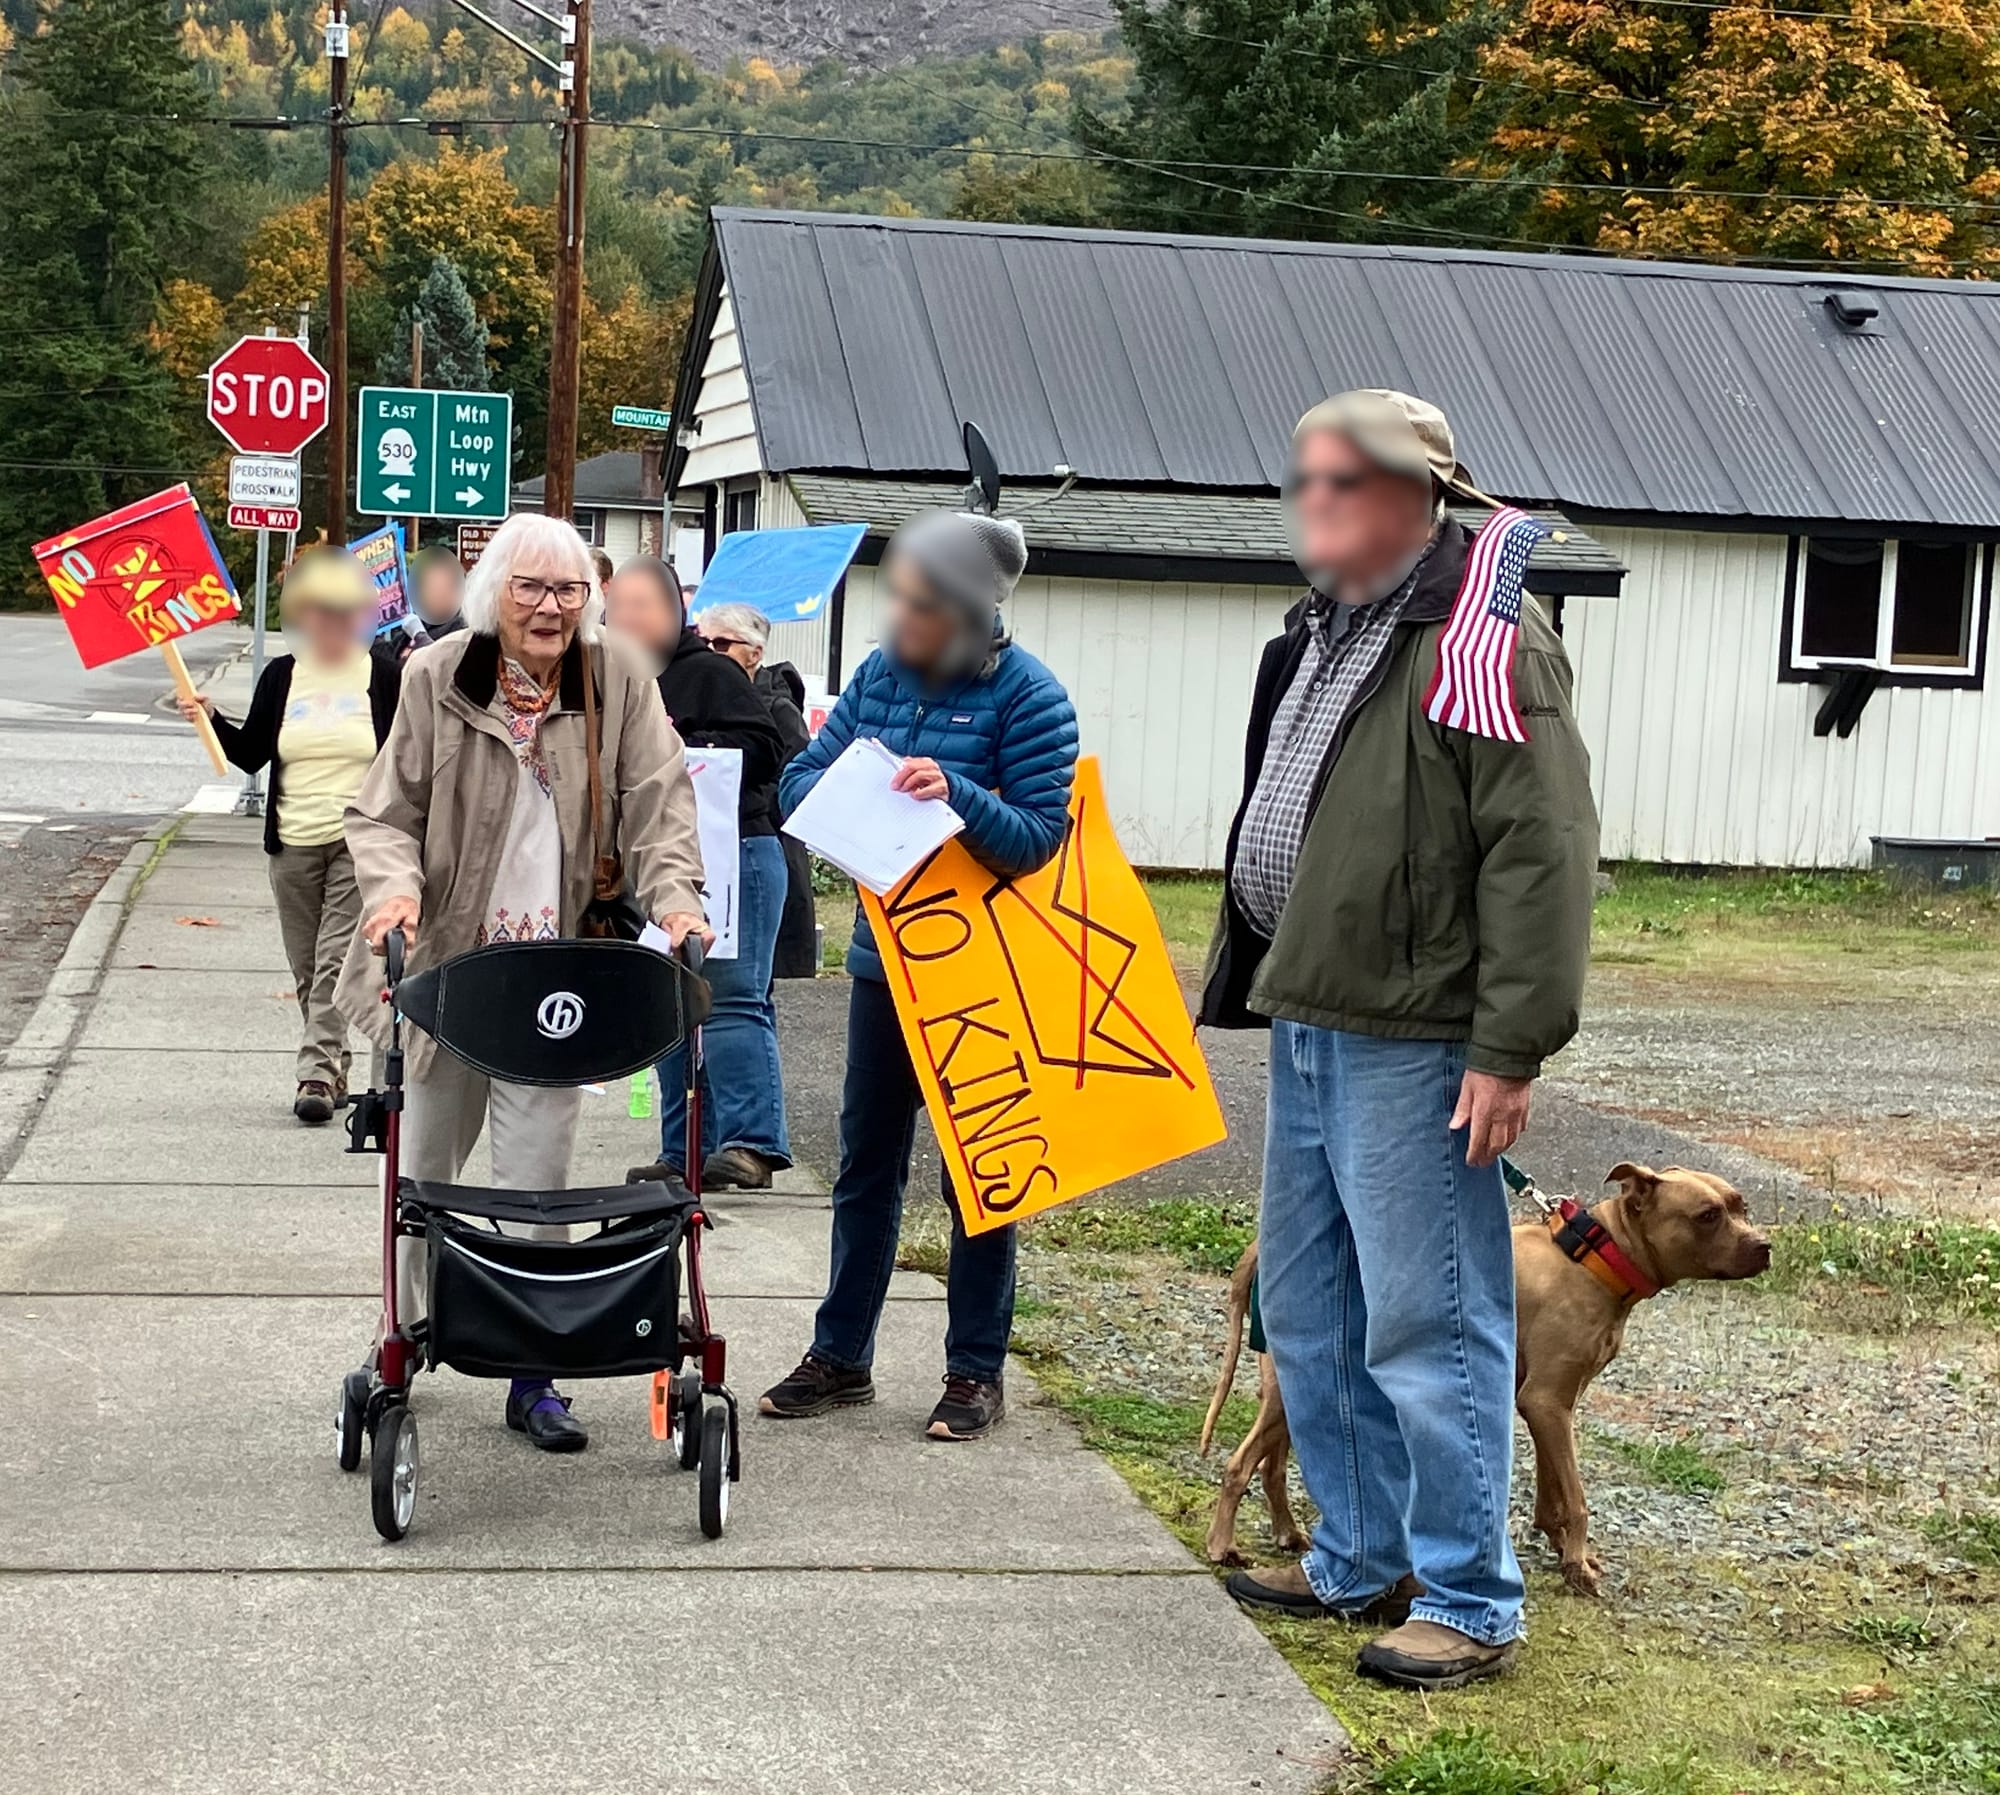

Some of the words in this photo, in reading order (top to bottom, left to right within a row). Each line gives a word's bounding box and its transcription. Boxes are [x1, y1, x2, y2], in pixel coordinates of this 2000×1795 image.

[213, 372, 325, 420] STOP
[378, 400, 418, 419] EAST
[455, 405, 490, 424] Mtn
[382, 443, 413, 459] 530
[450, 430, 493, 454] Loop
[234, 464, 297, 480] PEDESTRIAN
[451, 458, 491, 481] Hwy
[234, 482, 296, 498] CROSSWALK
[233, 509, 259, 525] ALL
[267, 511, 295, 528] WAY
[462, 529, 480, 539] OLD
[482, 529, 497, 540] TO
[355, 534, 395, 563] WHEN
[48, 550, 96, 608] NO
[126, 574, 231, 645] KINGS
[886, 844, 972, 961] NO
[919, 997, 1058, 1212] KINGS
